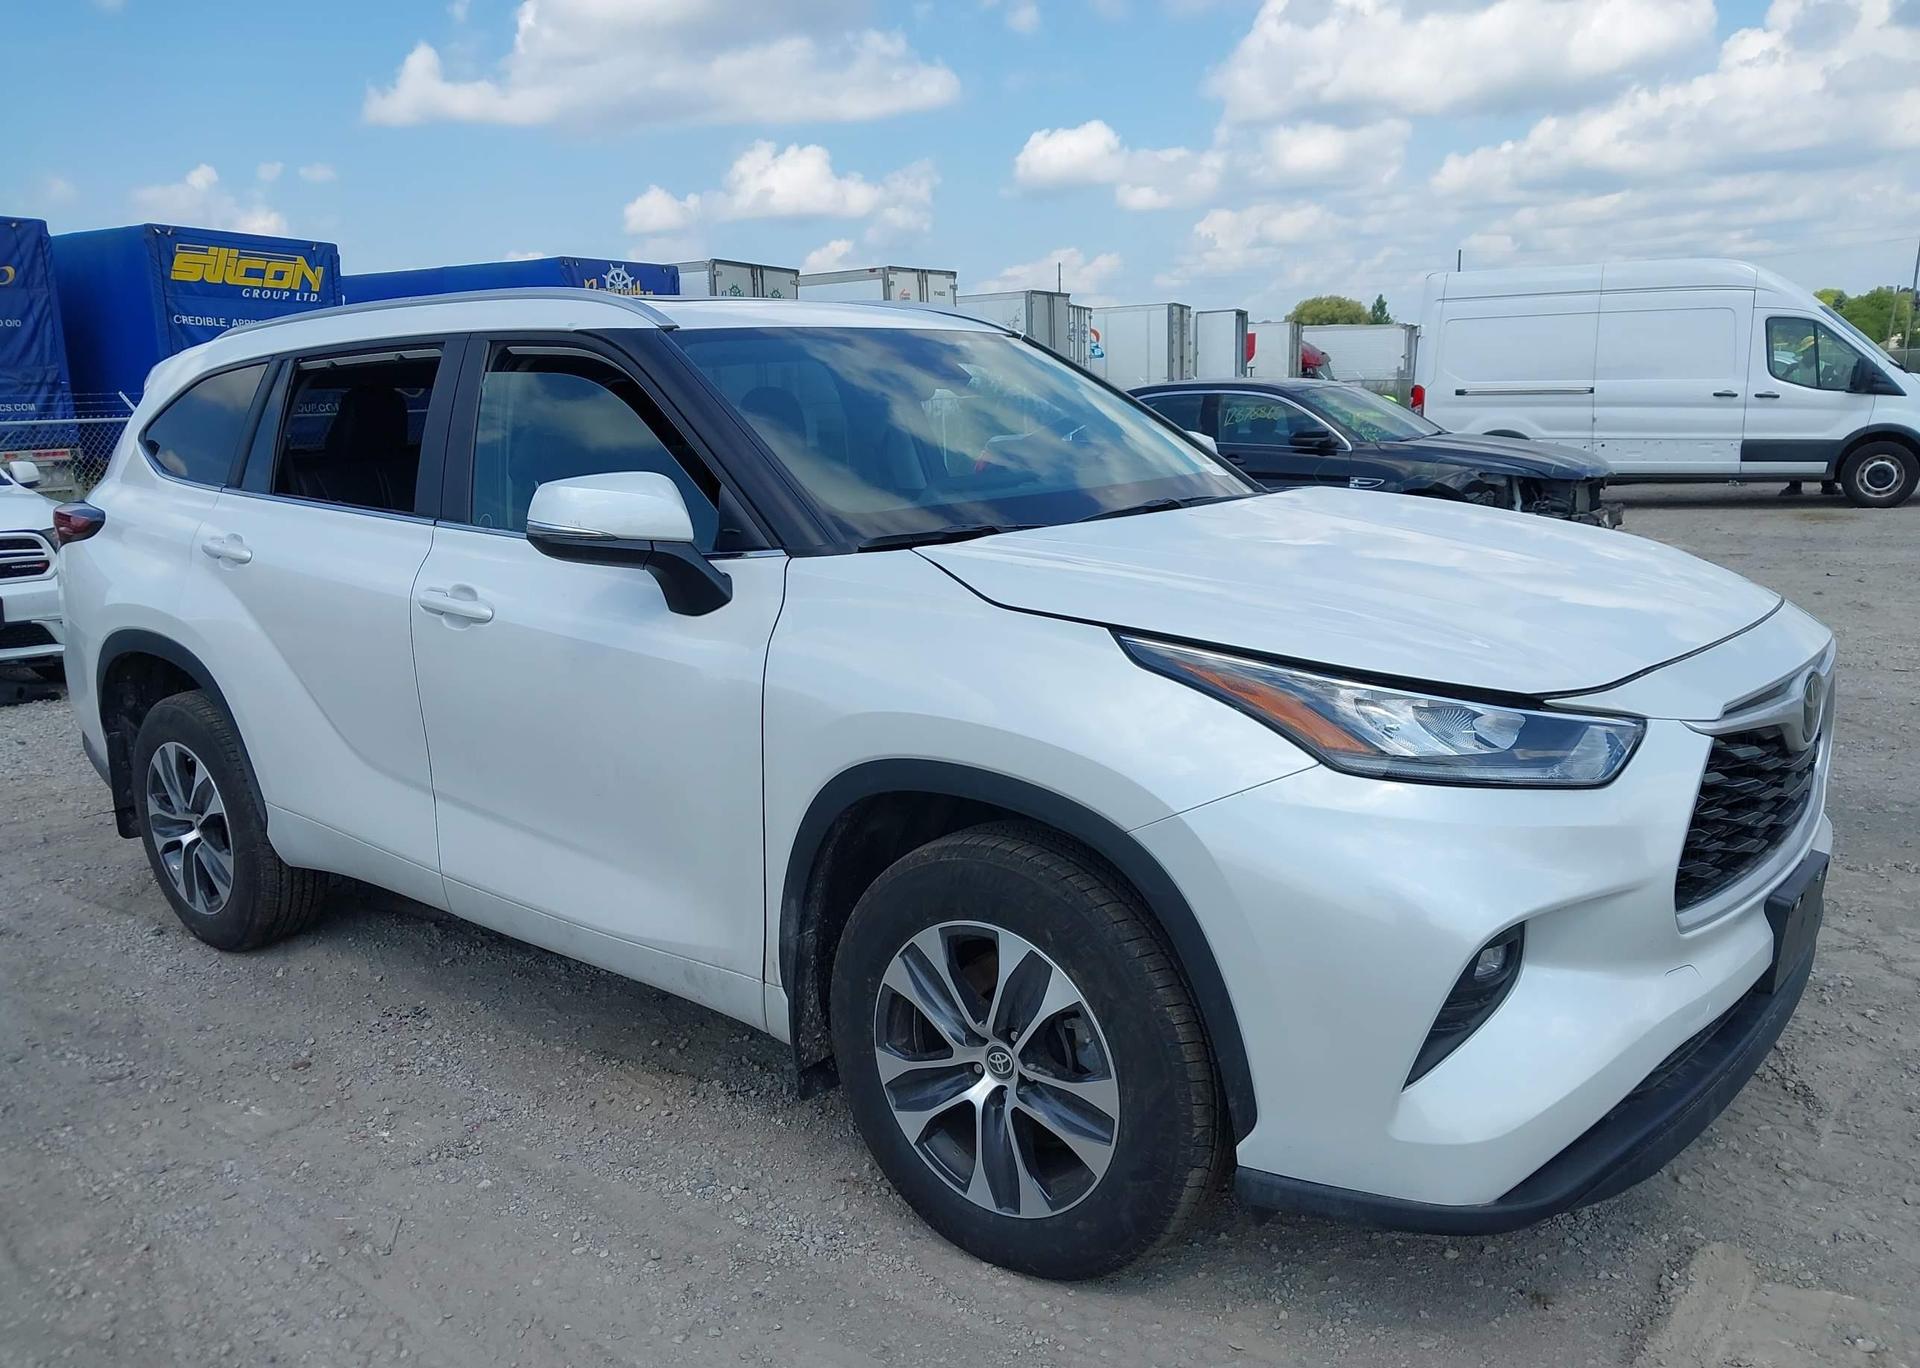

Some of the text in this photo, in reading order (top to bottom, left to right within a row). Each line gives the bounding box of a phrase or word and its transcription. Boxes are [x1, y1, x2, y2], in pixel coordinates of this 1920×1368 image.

[241, 288, 322, 303] GROUP LTD.
[173, 314, 230, 328] CREDIBLE,
